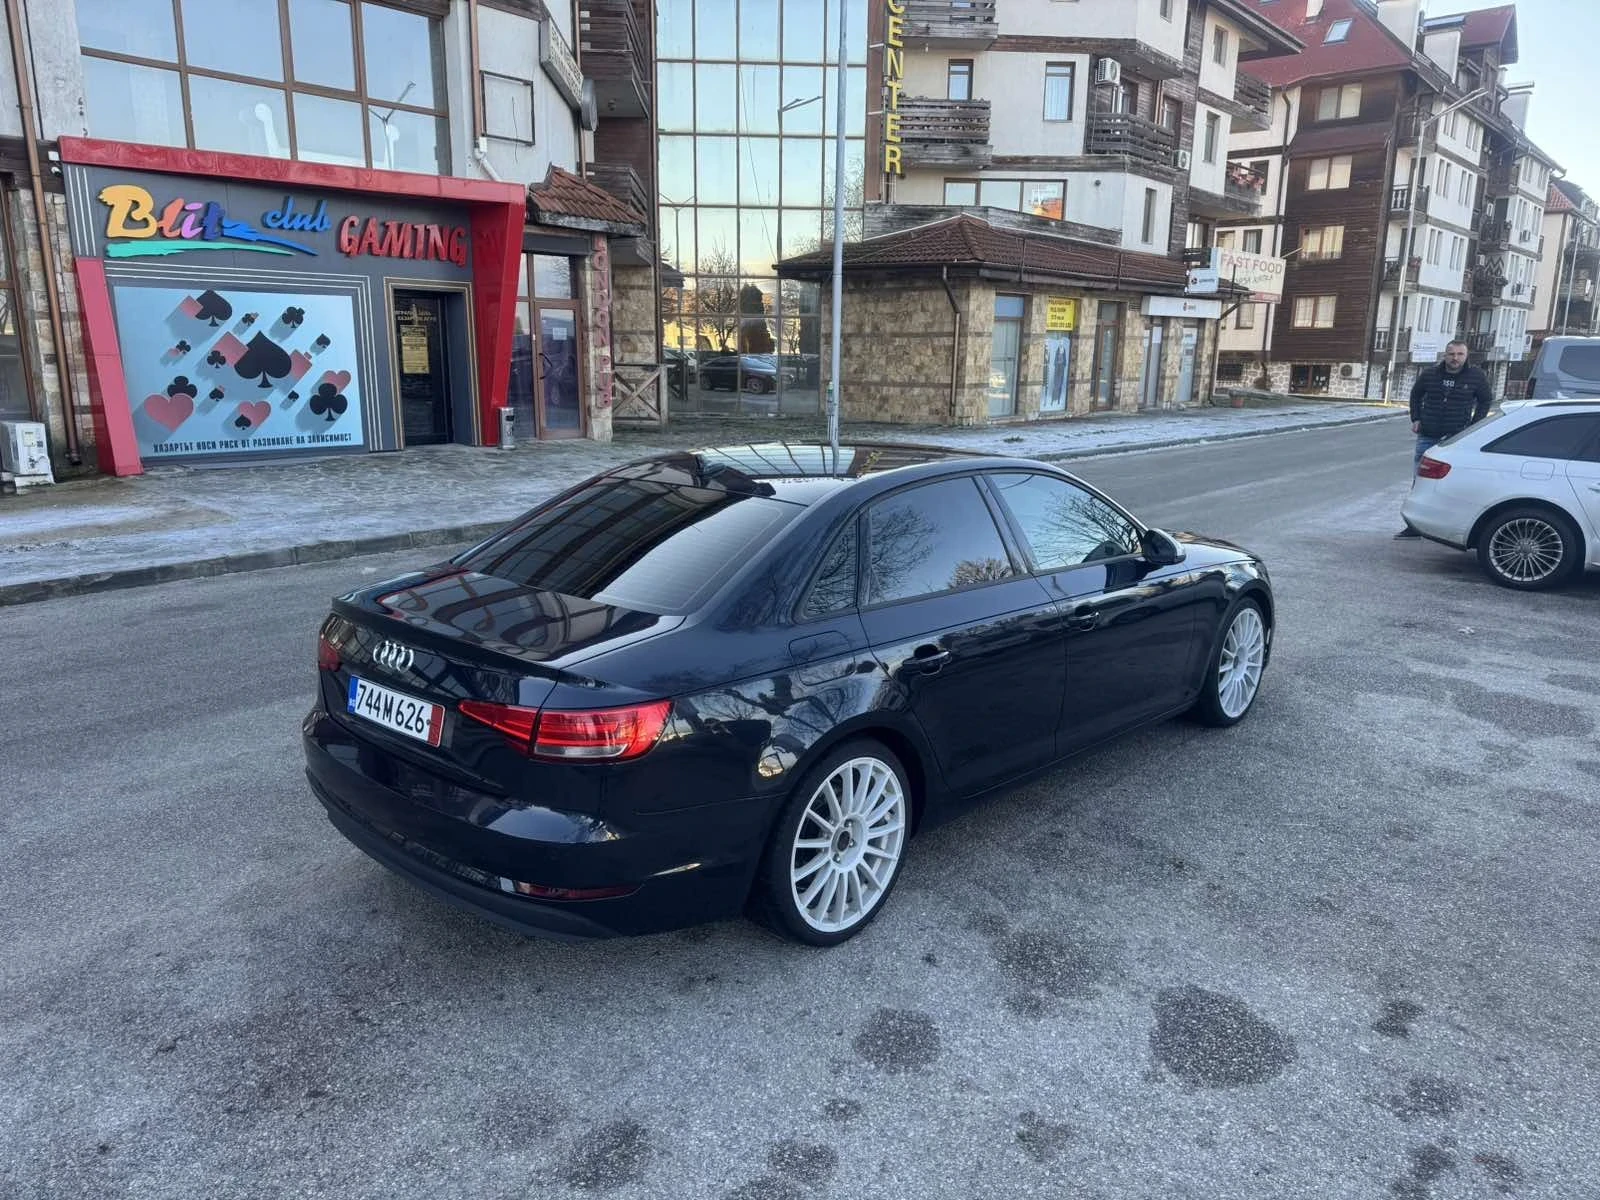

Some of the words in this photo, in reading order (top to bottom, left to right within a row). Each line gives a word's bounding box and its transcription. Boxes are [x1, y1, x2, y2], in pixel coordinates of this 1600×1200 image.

[98, 184, 304, 251] Blitz
[264, 196, 331, 232] club
[337, 215, 468, 268] GAMING
[1220, 254, 1251, 270] FAST
[1252, 259, 1283, 274] FOOD
[596, 355, 612, 408] PUB
[219, 439, 239, 450] РИСК
[296, 435, 306, 445] НА
